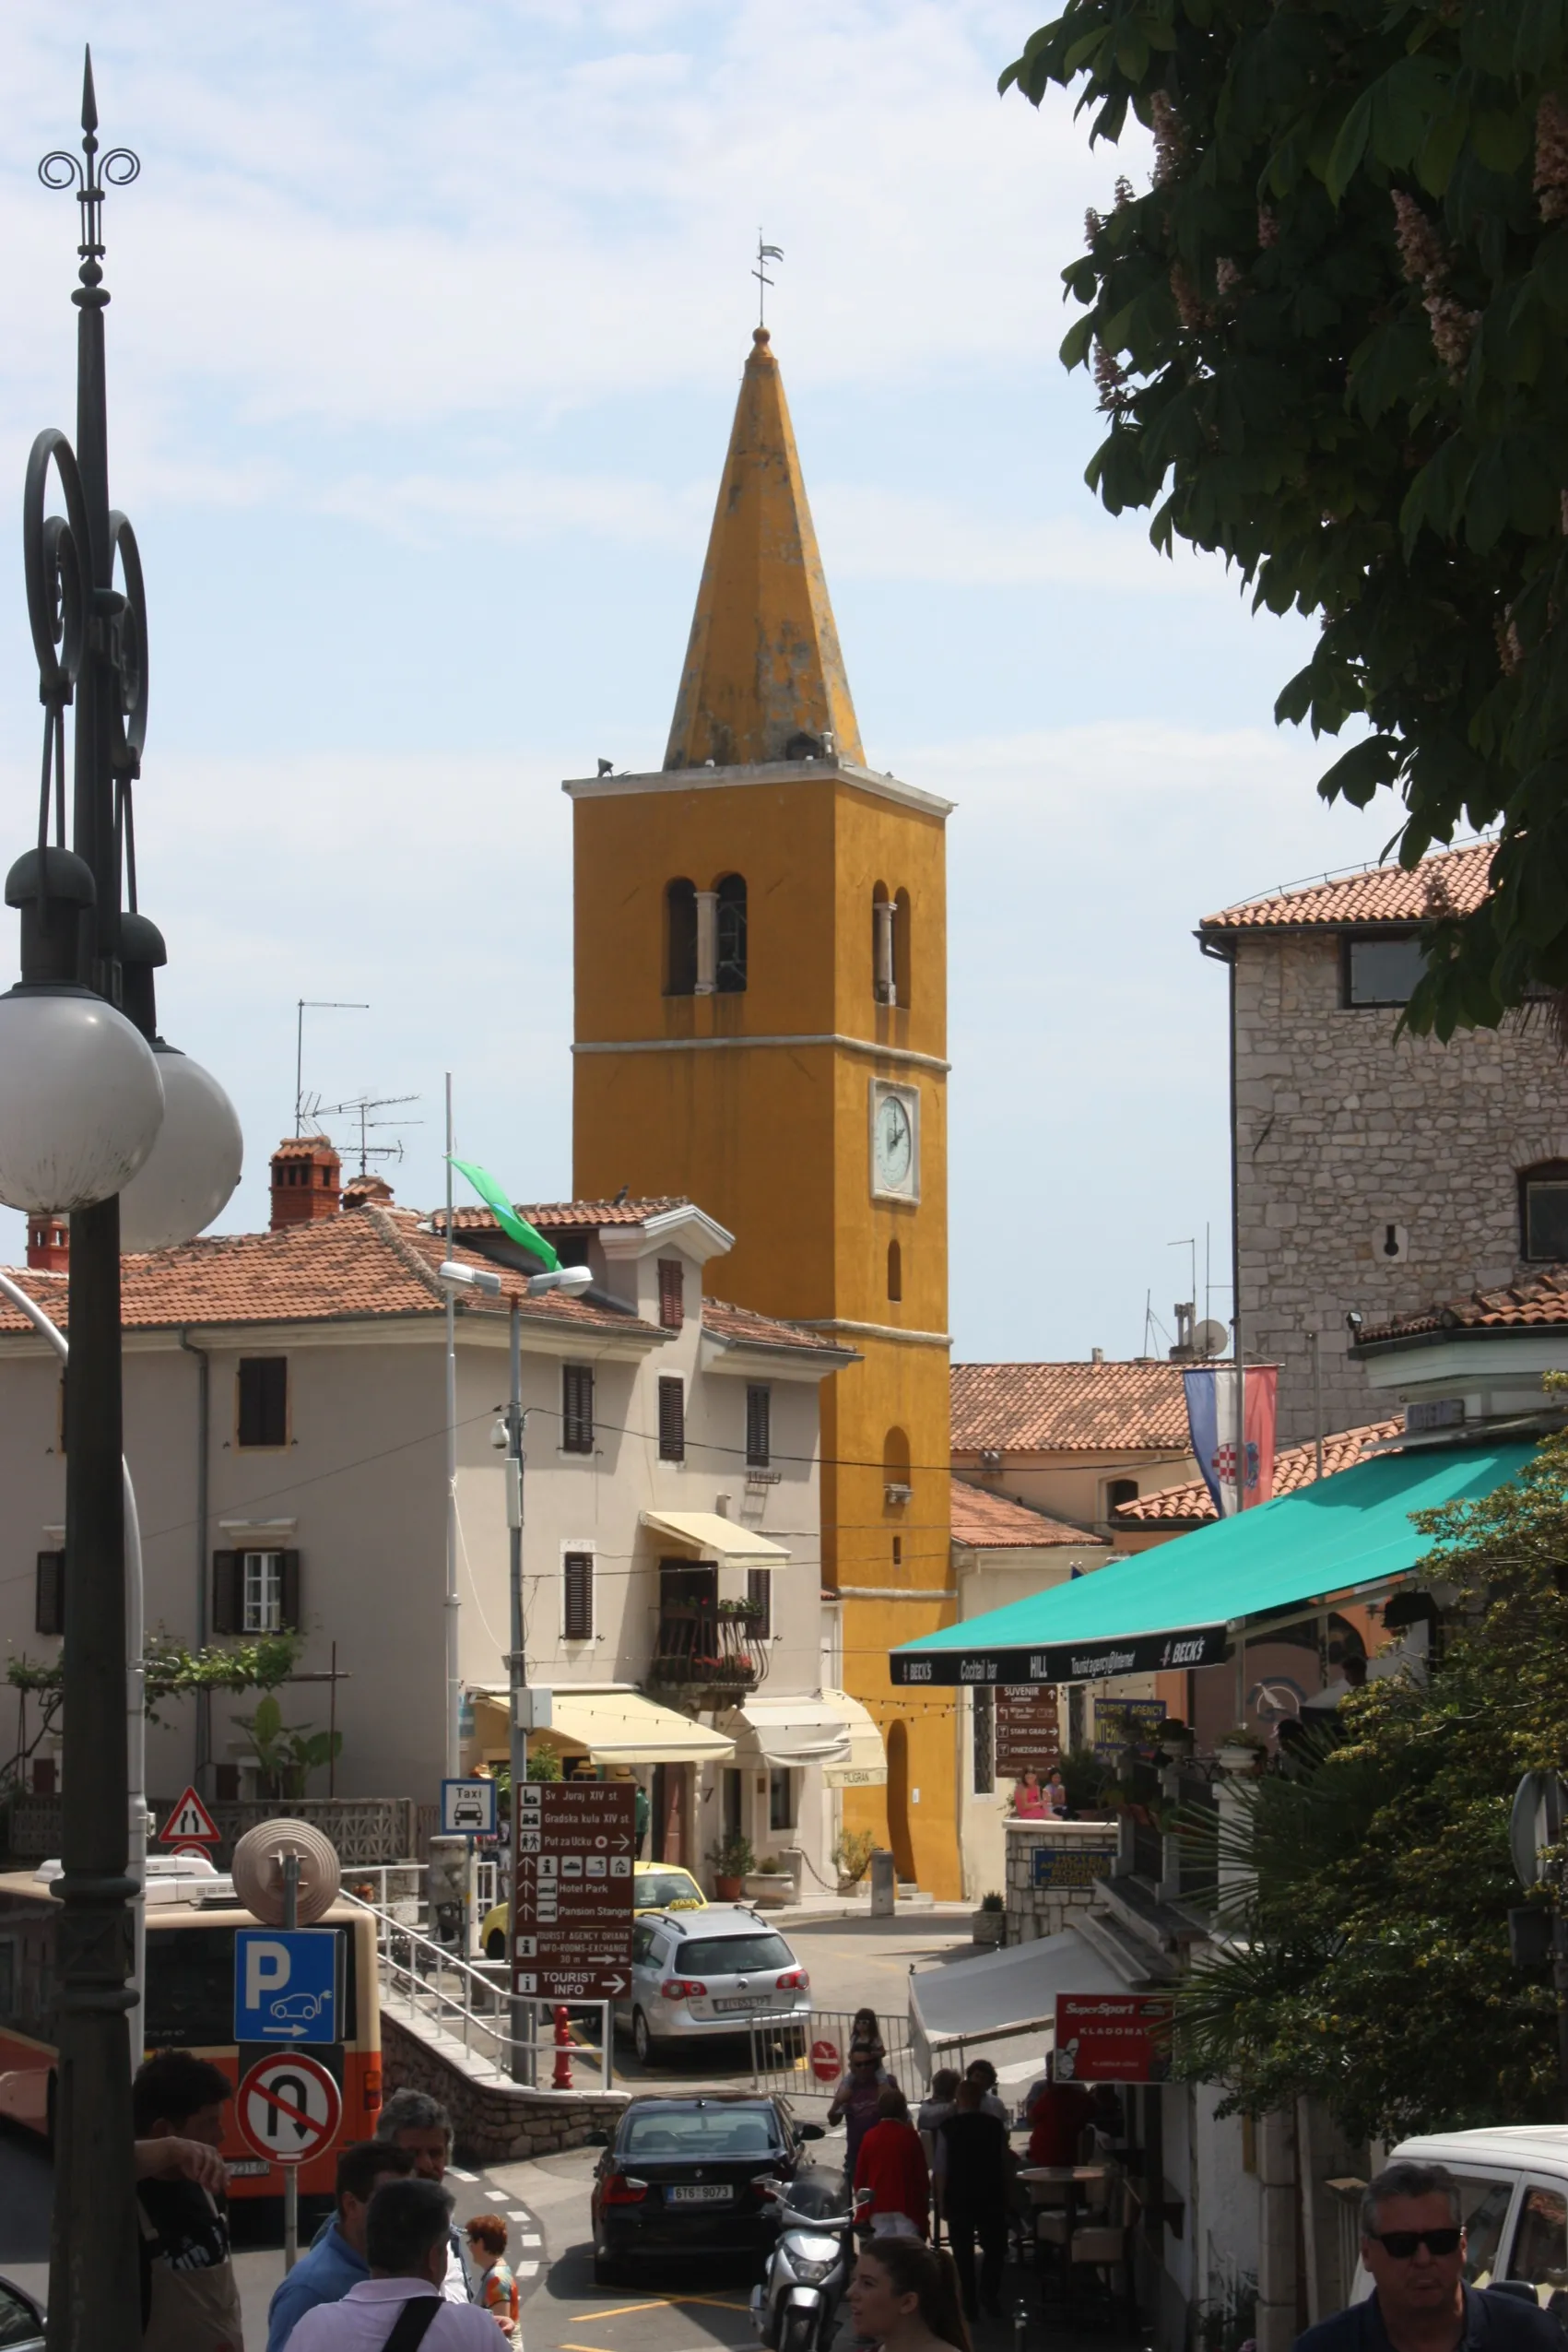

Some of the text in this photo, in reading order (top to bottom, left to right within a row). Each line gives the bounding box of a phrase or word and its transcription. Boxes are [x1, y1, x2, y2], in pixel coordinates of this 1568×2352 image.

[1172, 1636, 1206, 1663] BECK'S
[910, 1660, 932, 1680] BECK'S
[961, 1660, 998, 1680] Cocktail bar
[1030, 1656, 1048, 1678] HILL
[1004, 1686, 1040, 1696] SUVENIR
[1095, 1704, 1163, 1716] TOURIST AGENCY
[456, 1787, 482, 1799] Taxi
[562, 1791, 585, 1802] Juraj
[590, 1791, 605, 1801] XIV
[545, 1813, 579, 1824] Gradska
[581, 1813, 600, 1824] kula
[603, 1814, 619, 1824] XIV
[544, 1836, 559, 1847] Put
[560, 1838, 571, 1847] za
[559, 1884, 608, 1894] Hotel Park
[559, 1906, 631, 1919] Pansion Stanger
[536, 1931, 630, 1941] TOURIST AGENCY ORIANA
[539, 1943, 628, 1953] INFO-ROOMS-EXCHANGE
[560, 1955, 571, 1964] 30
[245, 1941, 291, 2010] P
[542, 1972, 597, 1983] TOURIST
[554, 1984, 584, 1995] INFO
[1066, 2002, 1135, 2016] SuperSport
[676, 2186, 728, 2199] 6T6 9073
